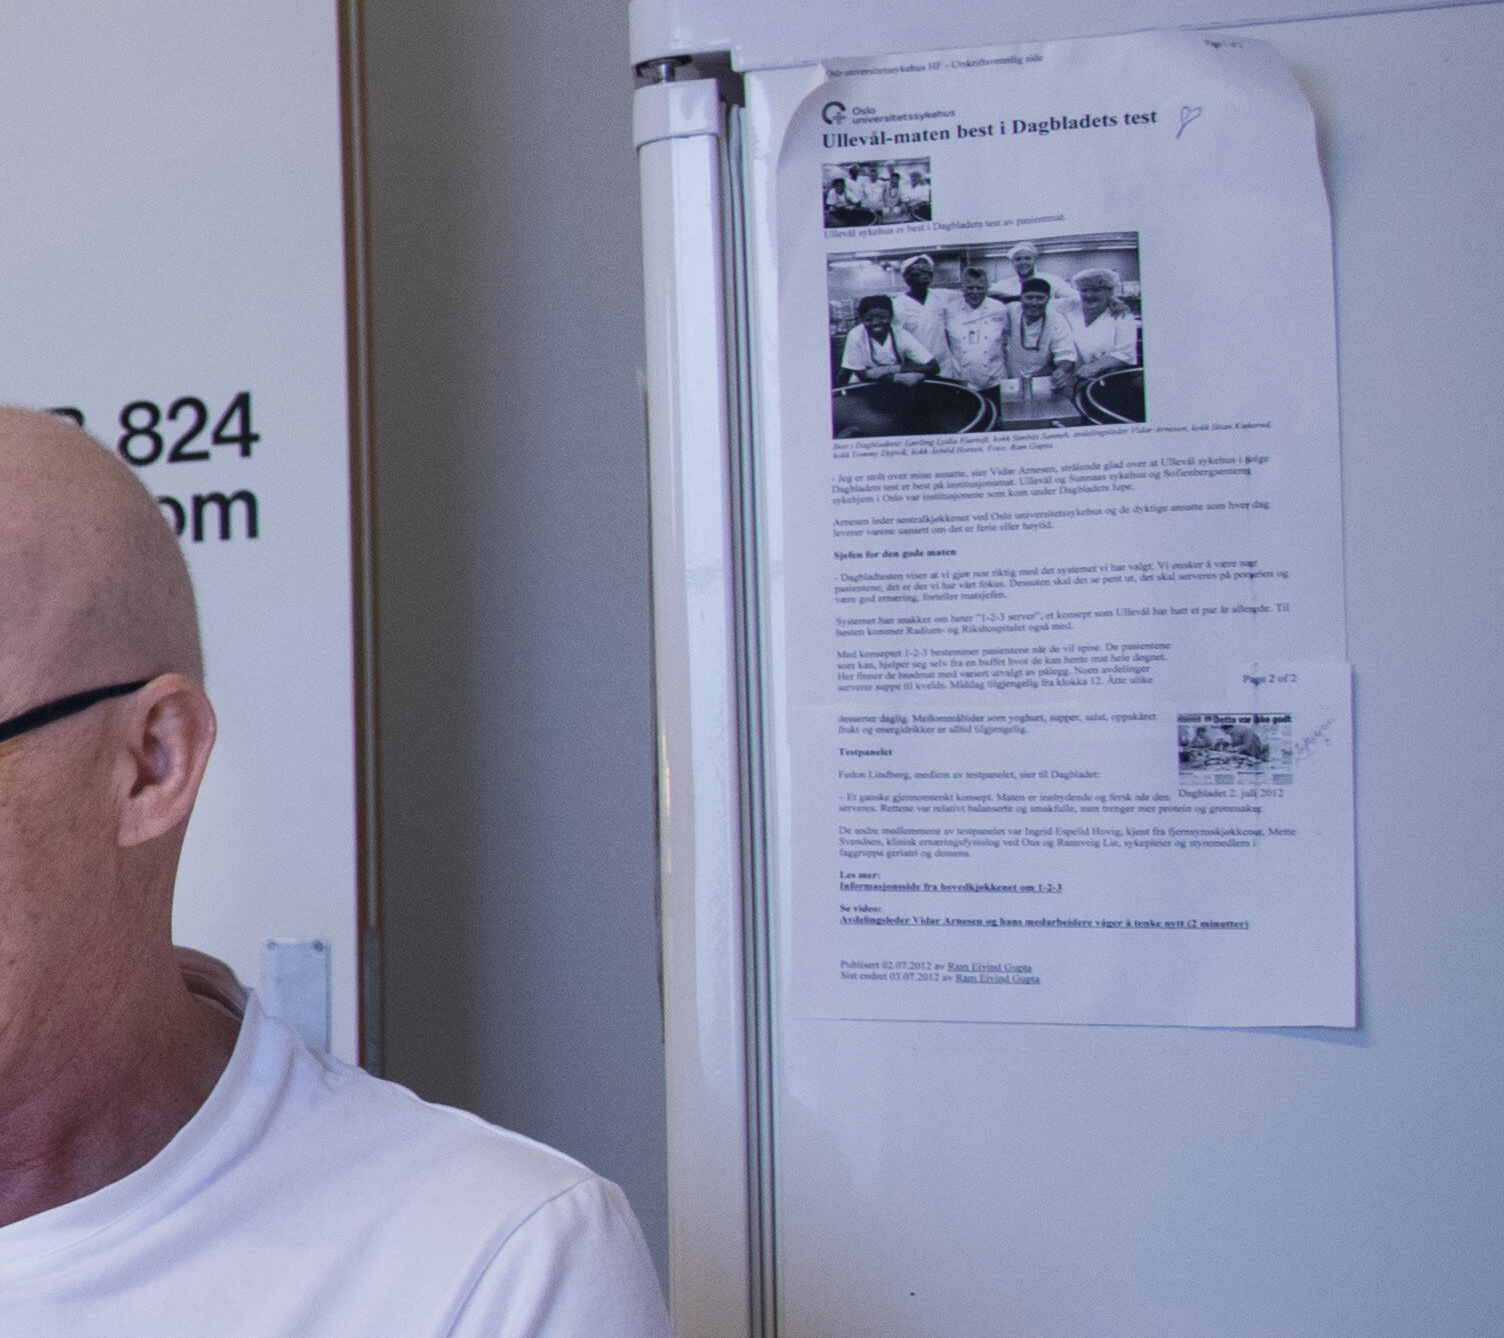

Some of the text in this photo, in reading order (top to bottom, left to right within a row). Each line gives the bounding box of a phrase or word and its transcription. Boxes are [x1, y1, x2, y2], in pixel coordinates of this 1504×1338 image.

[852, 106, 876, 117] Oslo
[852, 109, 956, 125] universitetssykehus
[822, 110, 1158, 149] Ullevål-maten best i Dagbladets test
[118, 391, 260, 467] 824
[834, 547, 956, 562] Sjefen for den gode maten
[838, 746, 892, 758] Testpanelet
[1178, 788, 1227, 800] Dagbladet
[1260, 788, 1284, 798] 2012
[840, 870, 855, 879] Les
[923, 881, 938, 891] fra
[1038, 882, 1062, 892] 1-2-3
[913, 915, 940, 925] Vidar
[943, 916, 982, 926] Arnesen
[999, 916, 1022, 926] hans
[1024, 916, 1092, 927] medarbeidere
[1095, 917, 1122, 930] våger
[1134, 917, 1161, 927] tenke
[1164, 918, 1184, 930] nytt
[1200, 918, 1248, 931] minutter)
[840, 960, 879, 970] Publisert
[881, 961, 931, 971] 02.07.2012
[947, 962, 969, 971] Ram
[971, 962, 1001, 971] Eivind
[1004, 962, 1031, 974] Gupta
[840, 971, 857, 981] Sist
[859, 971, 887, 981] endret
[889, 972, 939, 982] 03.07.2012
[955, 973, 977, 983] Ram
[979, 973, 1009, 983] Eivind
[1011, 974, 1040, 986] Gupta
